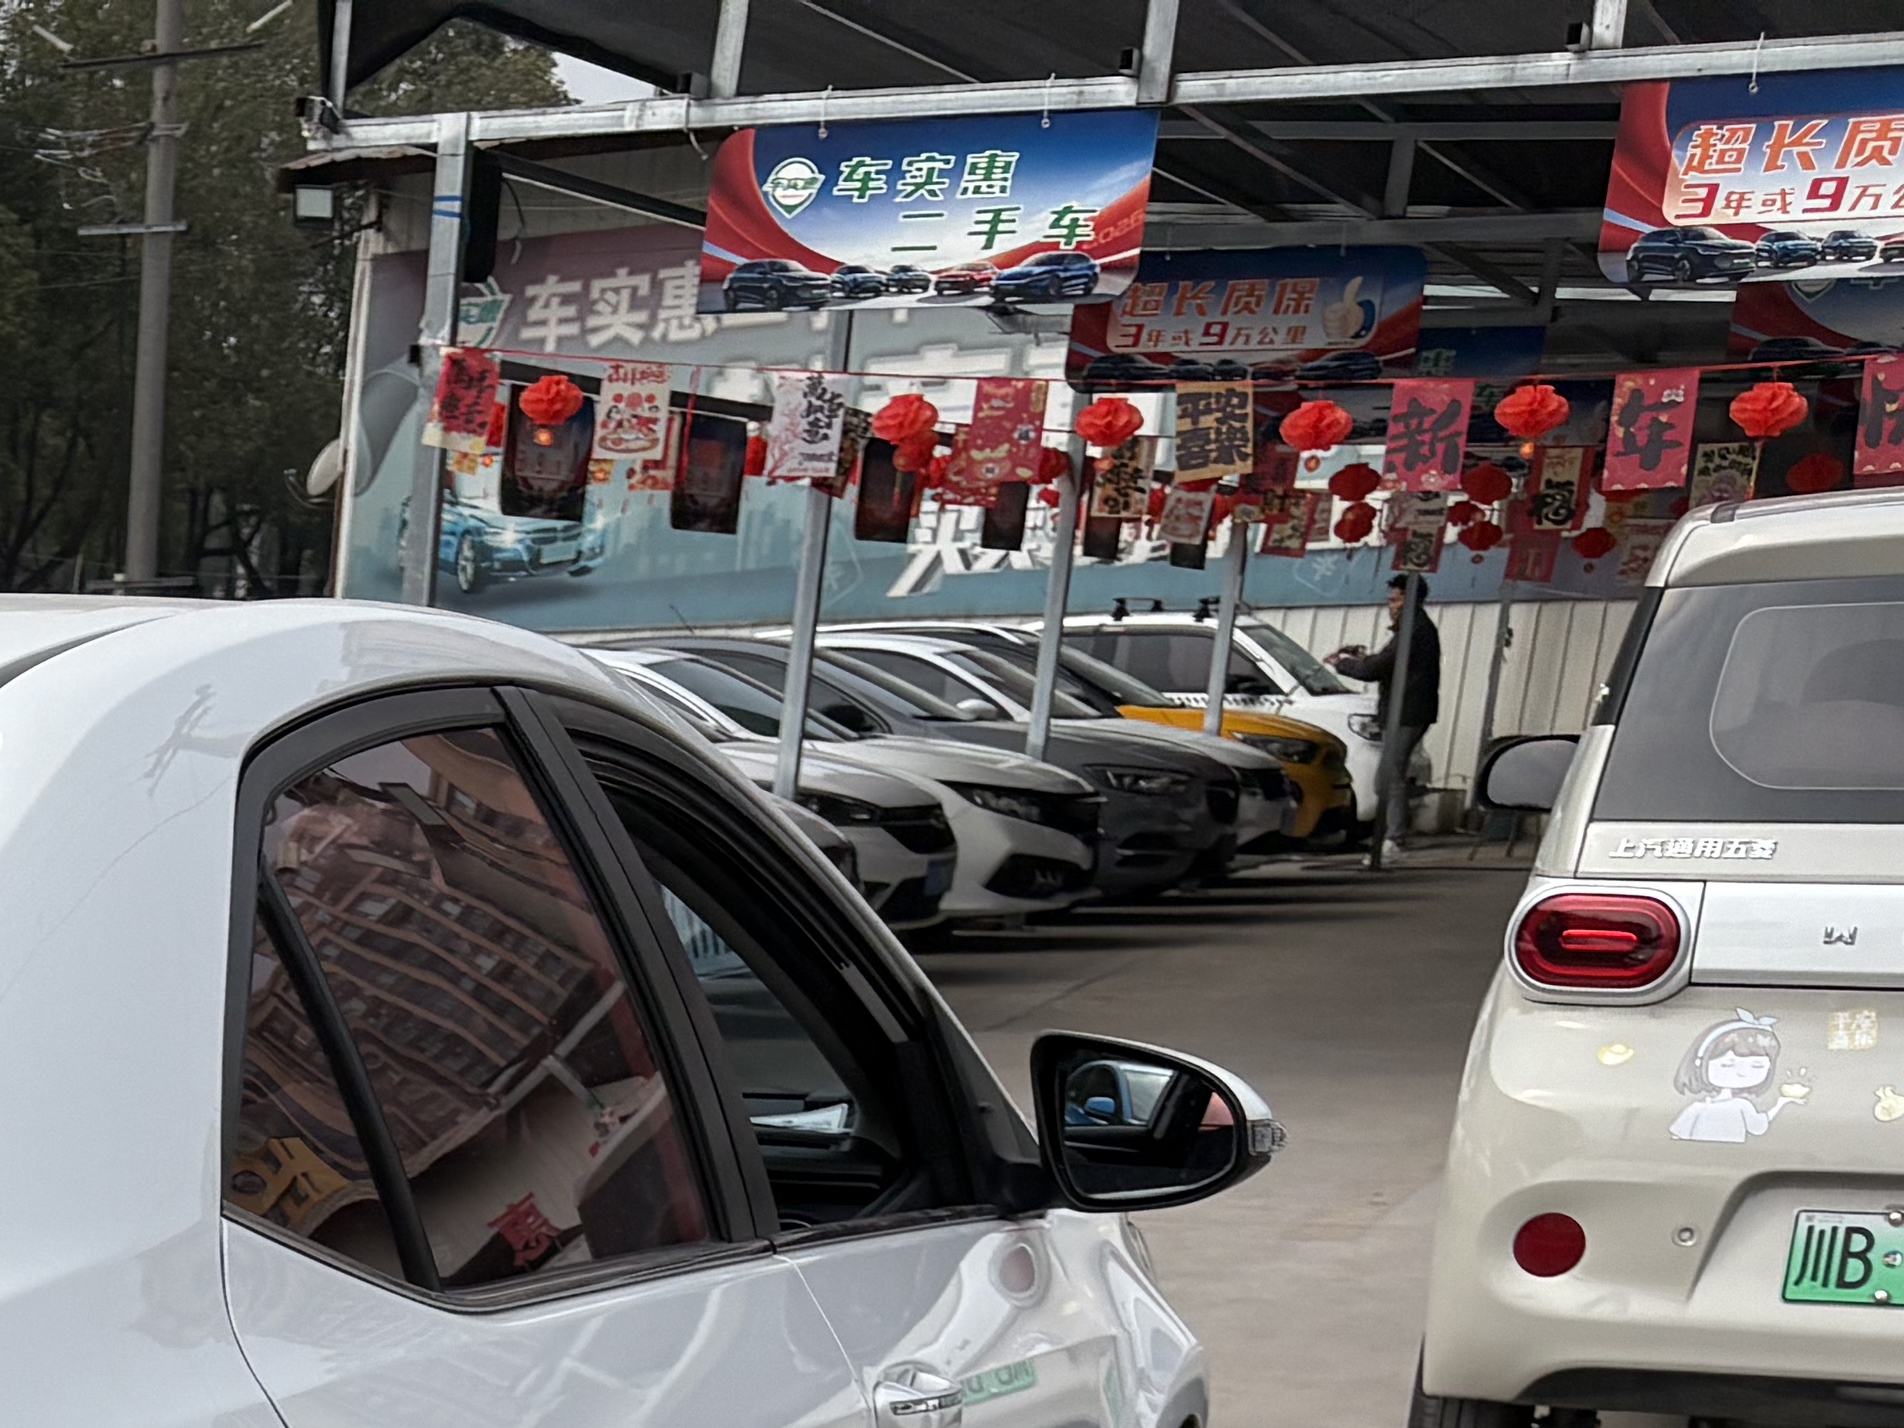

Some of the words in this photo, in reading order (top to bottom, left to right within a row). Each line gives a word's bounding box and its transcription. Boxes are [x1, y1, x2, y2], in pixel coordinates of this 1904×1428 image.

[833, 149, 1020, 203] 车实惠
[890, 201, 1099, 253] 二手车
[1120, 278, 1320, 317] 超长质保
[1114, 321, 1308, 348] 3年或9万公里
[1385, 397, 1463, 475] 新
[1613, 388, 1684, 471] 年
[1608, 837, 1779, 859] 上汽通用五菱
